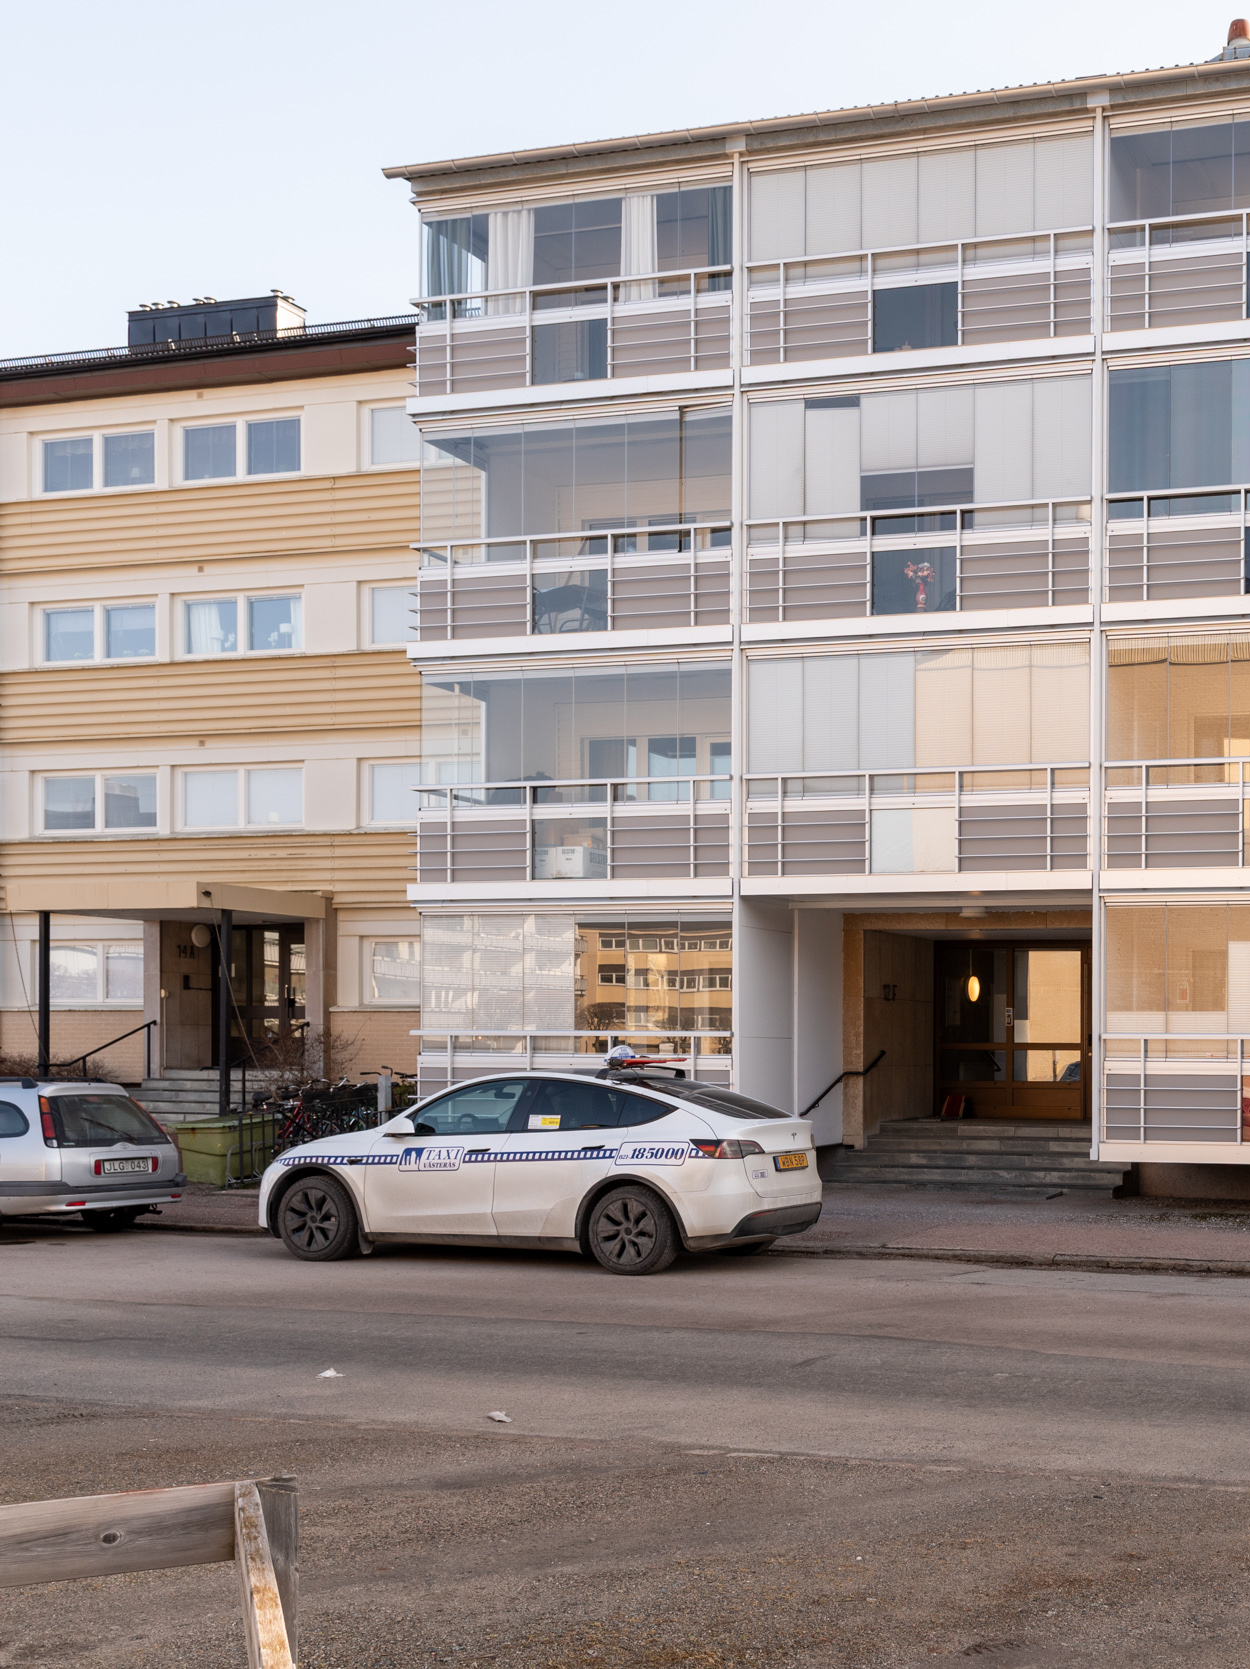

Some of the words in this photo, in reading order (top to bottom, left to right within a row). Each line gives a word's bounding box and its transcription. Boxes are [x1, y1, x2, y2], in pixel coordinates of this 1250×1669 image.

[425, 1149, 462, 1161] TAXI
[106, 1161, 125, 1172] JLG
[130, 1160, 147, 1170] 043
[423, 1160, 456, 1169] VÄSTERÅS
